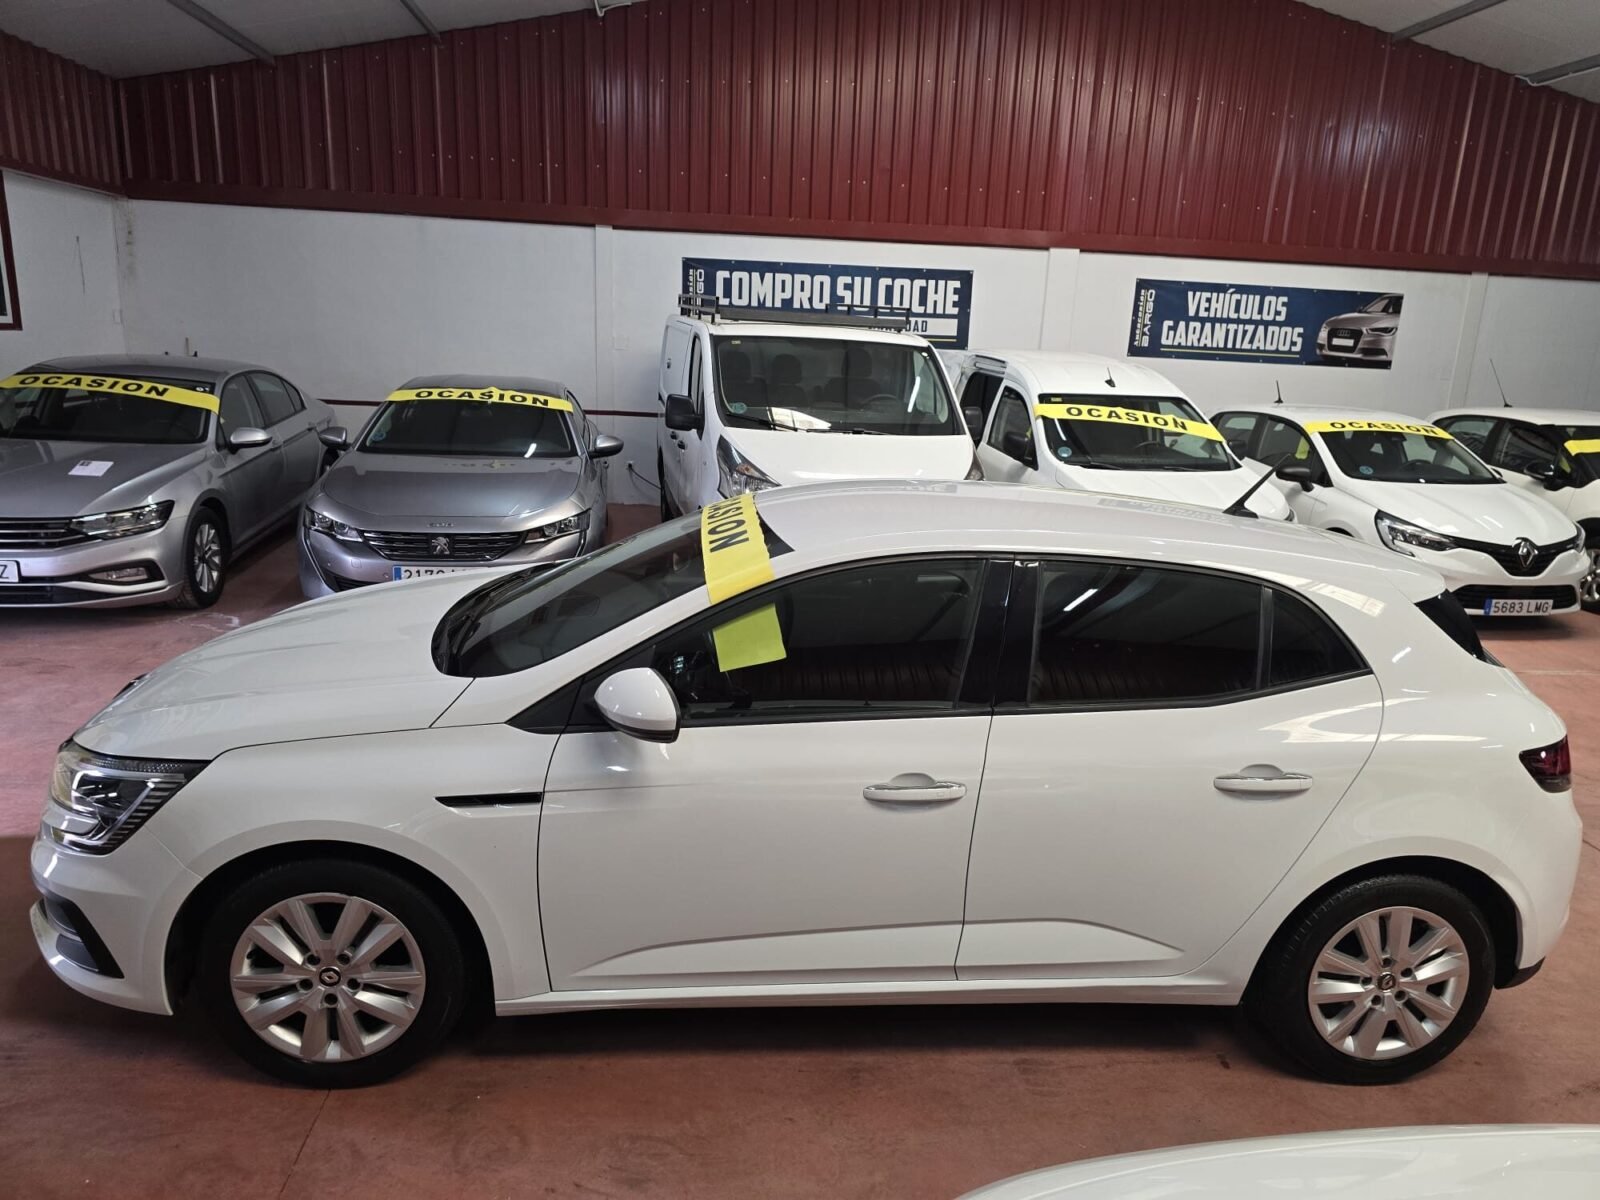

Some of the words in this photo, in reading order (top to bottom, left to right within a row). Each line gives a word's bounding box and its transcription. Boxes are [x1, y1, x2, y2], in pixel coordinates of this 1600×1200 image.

[715, 269, 831, 309] COMPRO
[836, 275, 872, 311] SU
[878, 277, 961, 314] COCHE
[1141, 289, 1156, 347] BARGO
[1187, 288, 1289, 322] VEHÍCULOS
[1160, 320, 1304, 352] GARANTIZADOS
[19, 375, 171, 397] OCASION
[414, 389, 549, 407] OCASION
[1065, 406, 1189, 432] OCASION
[1329, 421, 1439, 436] OCASION
[1493, 601, 1524, 614] 5683
[1526, 601, 1550, 614] LMG
